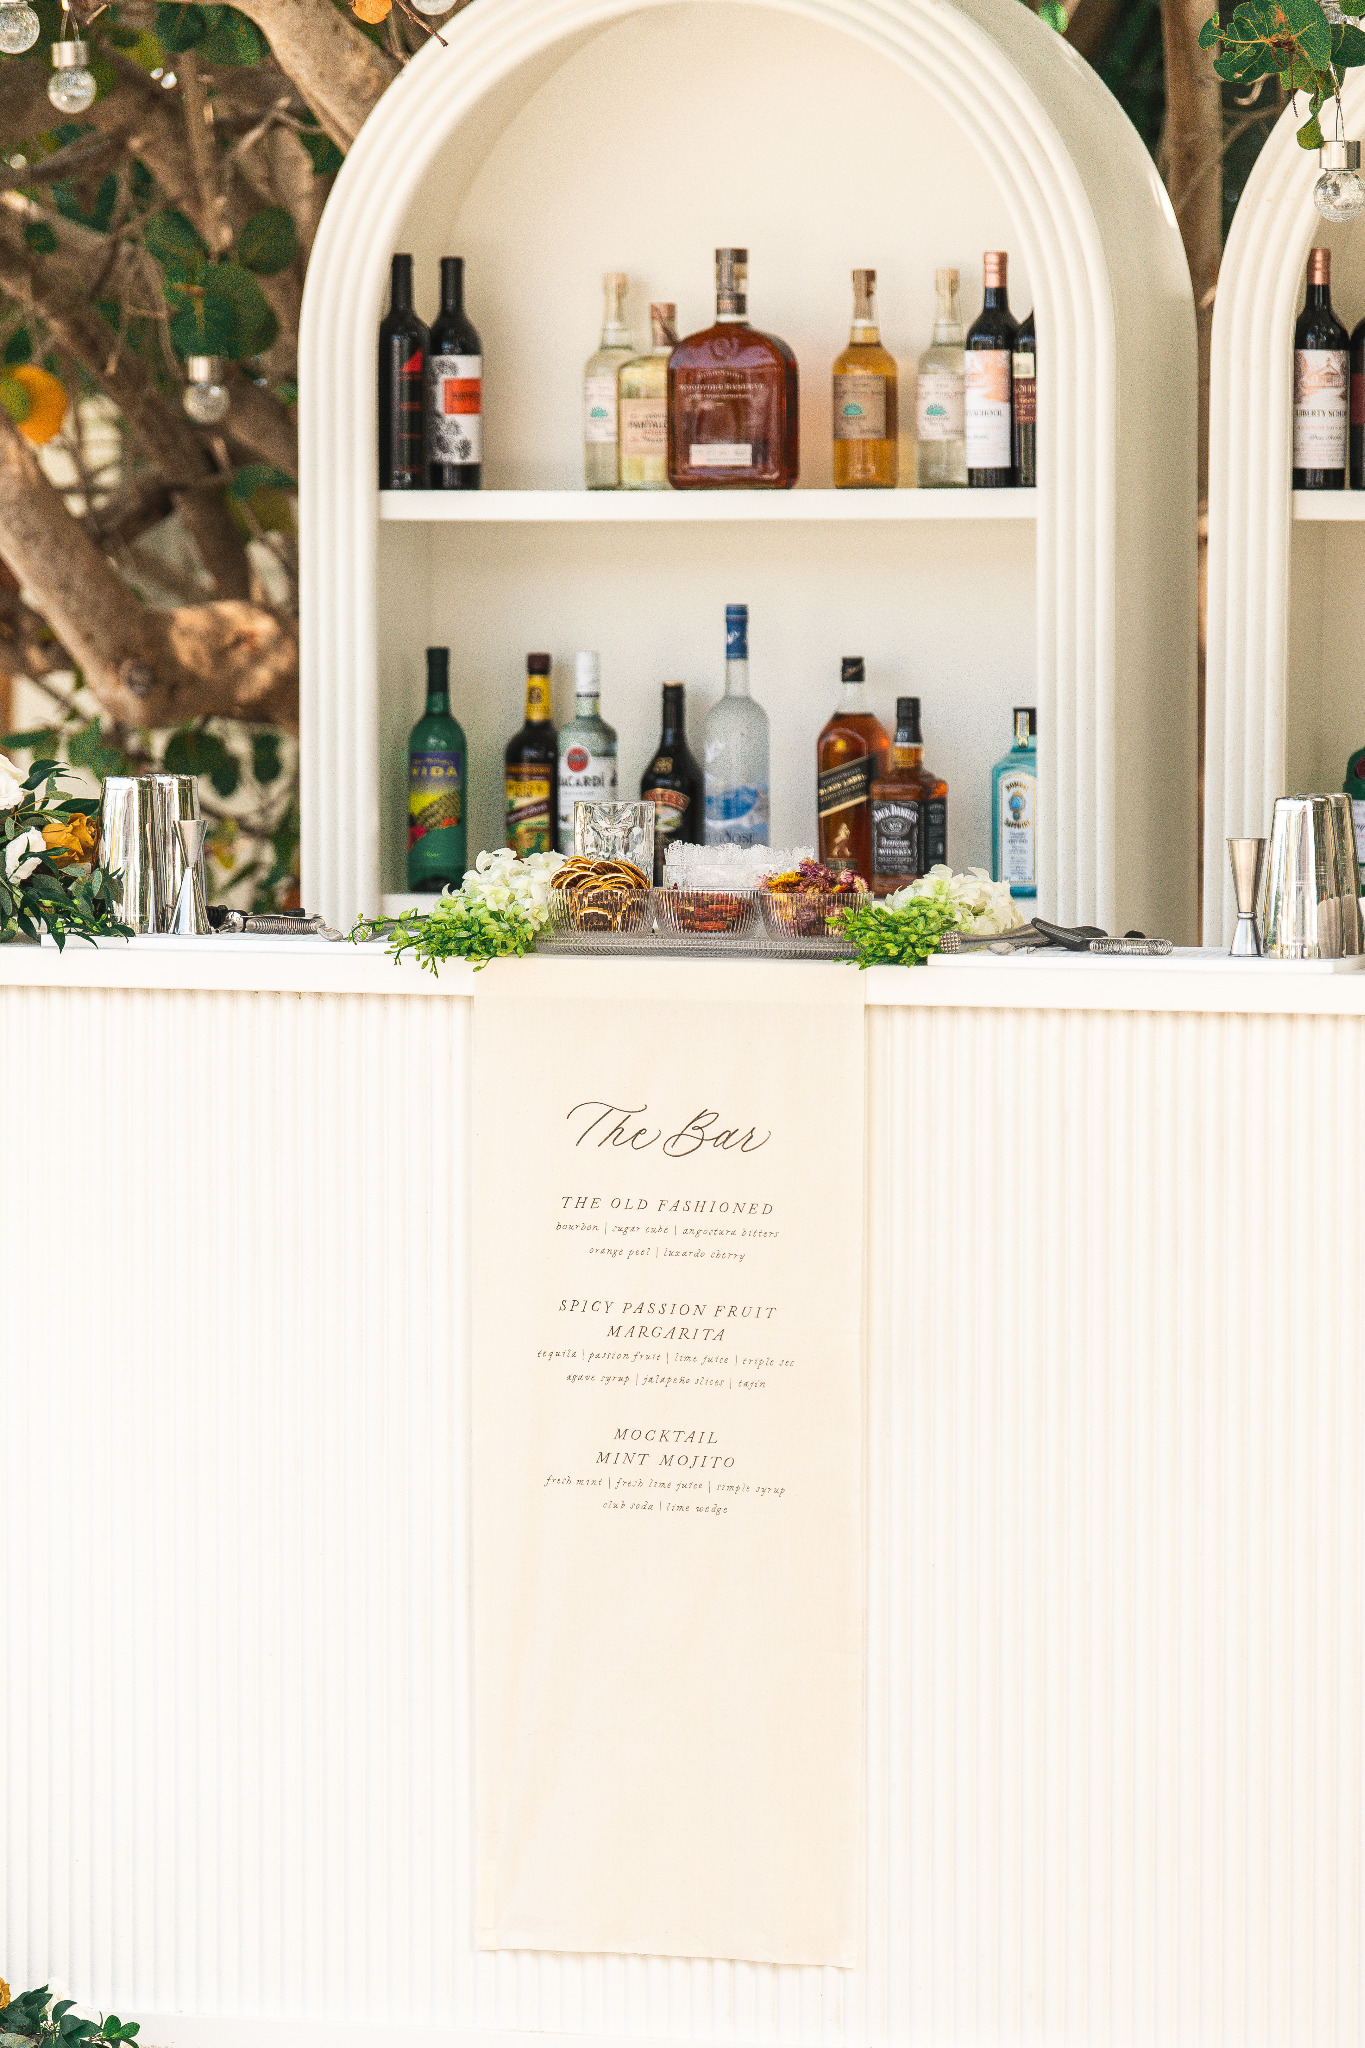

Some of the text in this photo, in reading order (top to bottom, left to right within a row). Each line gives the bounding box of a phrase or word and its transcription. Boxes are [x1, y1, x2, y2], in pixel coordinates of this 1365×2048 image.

[559, 772, 605, 787] ACARDÍ
[567, 1102, 771, 1157] The Bar
[562, 1197, 772, 1214] THE OLD FASHIONED
[555, 1222, 779, 1238] bourbon sugar cube angostura bitters
[589, 1248, 745, 1262] orange peel luxardo cherry
[559, 1300, 777, 1318] SPICY PASSION FRUIT
[606, 1326, 725, 1341] MARGARITA
[642, 1375, 690, 1387] jalapeño
[613, 1428, 718, 1444] MOCKTAIL
[596, 1452, 734, 1469] MINT MOJITO
[544, 1475, 571, 1487] fresh
[615, 1478, 643, 1489] fresh
[649, 1479, 671, 1488] lime
[675, 1481, 702, 1491] juice
[717, 1483, 750, 1494] simple
[756, 1487, 785, 1497] syrup
[603, 1501, 727, 1516] club soda lime wedge
